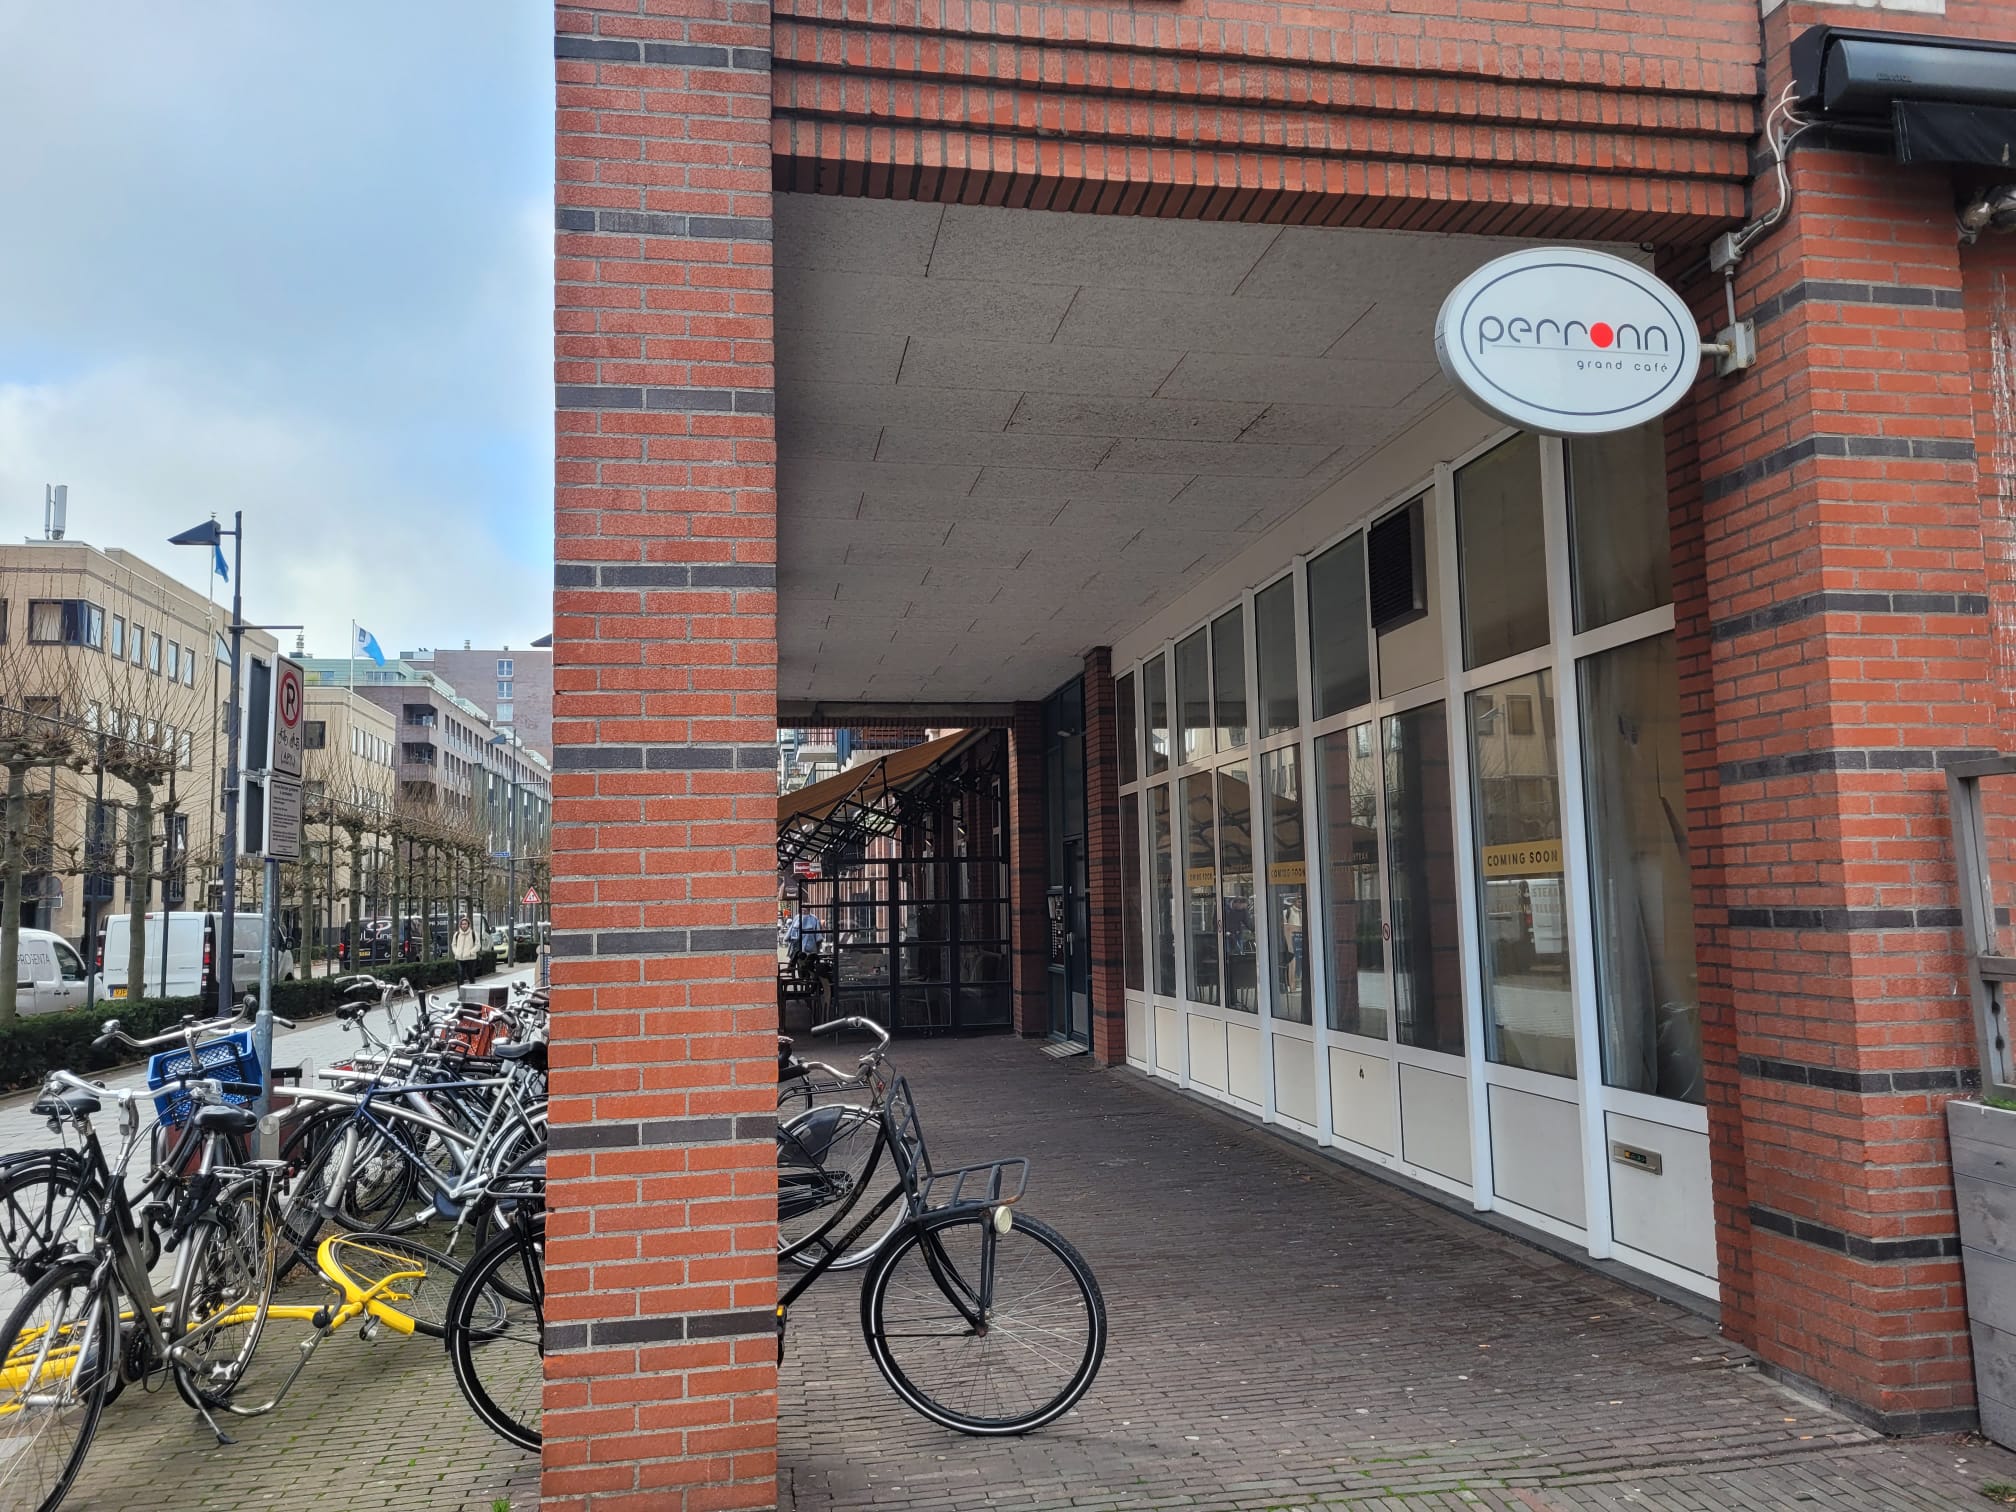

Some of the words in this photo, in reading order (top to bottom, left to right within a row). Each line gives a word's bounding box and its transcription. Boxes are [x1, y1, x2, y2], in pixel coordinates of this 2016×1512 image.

[1576, 358, 1623, 371] grand
[1634, 361, 1669, 373] café
[1487, 851, 1526, 867] COMING
[1529, 849, 1558, 864] SOON
